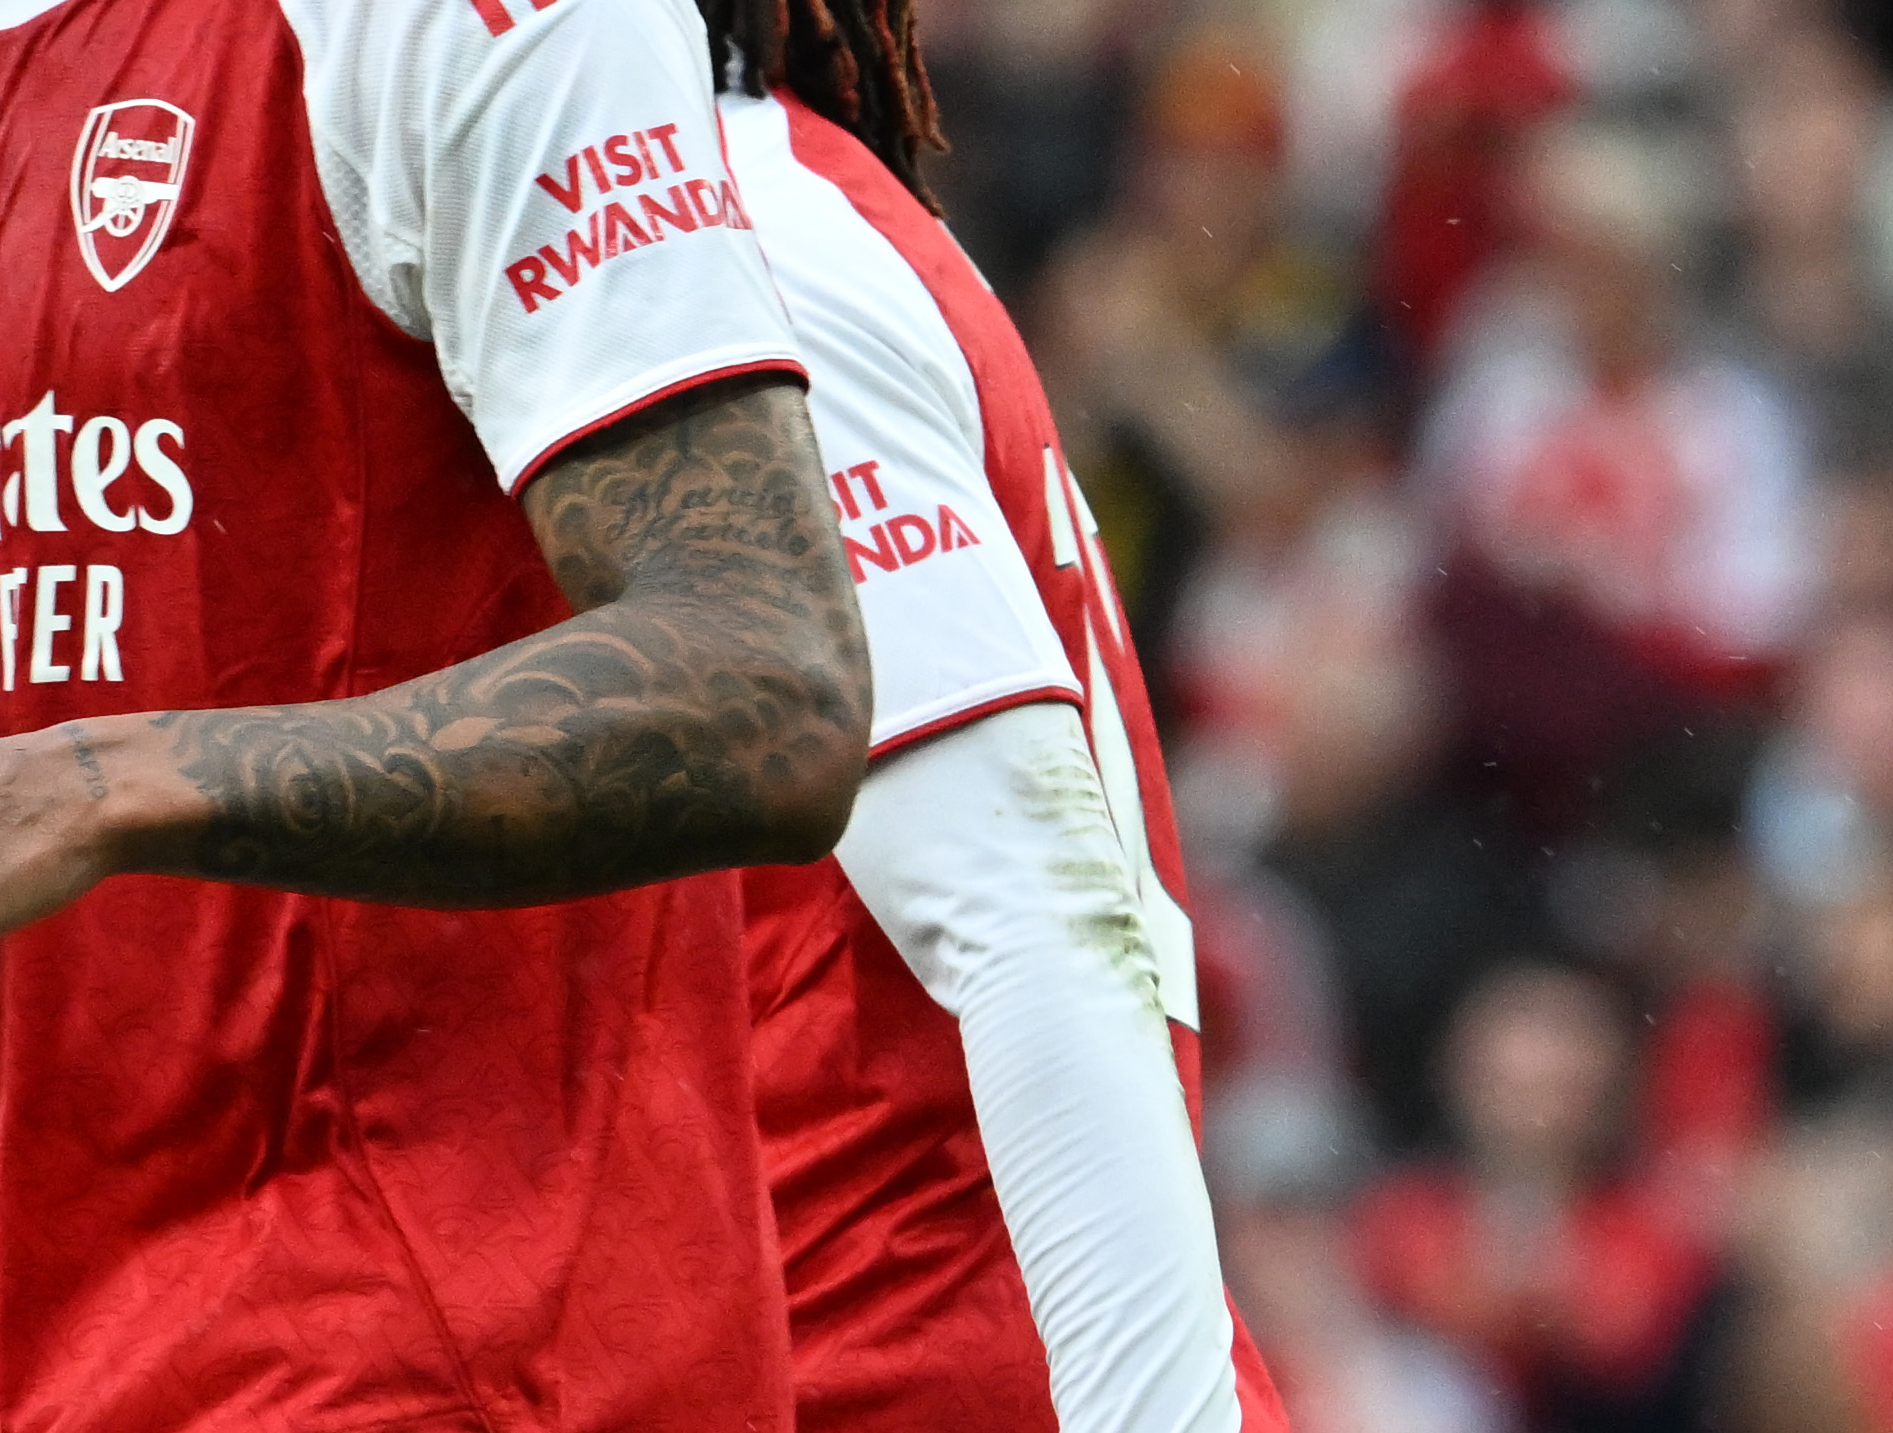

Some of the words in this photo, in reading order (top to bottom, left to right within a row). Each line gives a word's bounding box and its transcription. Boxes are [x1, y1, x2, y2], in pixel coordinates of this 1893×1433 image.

[534, 122, 686, 214] VISIT
[505, 178, 754, 314] RWANDA
[841, 503, 982, 585] NDA
